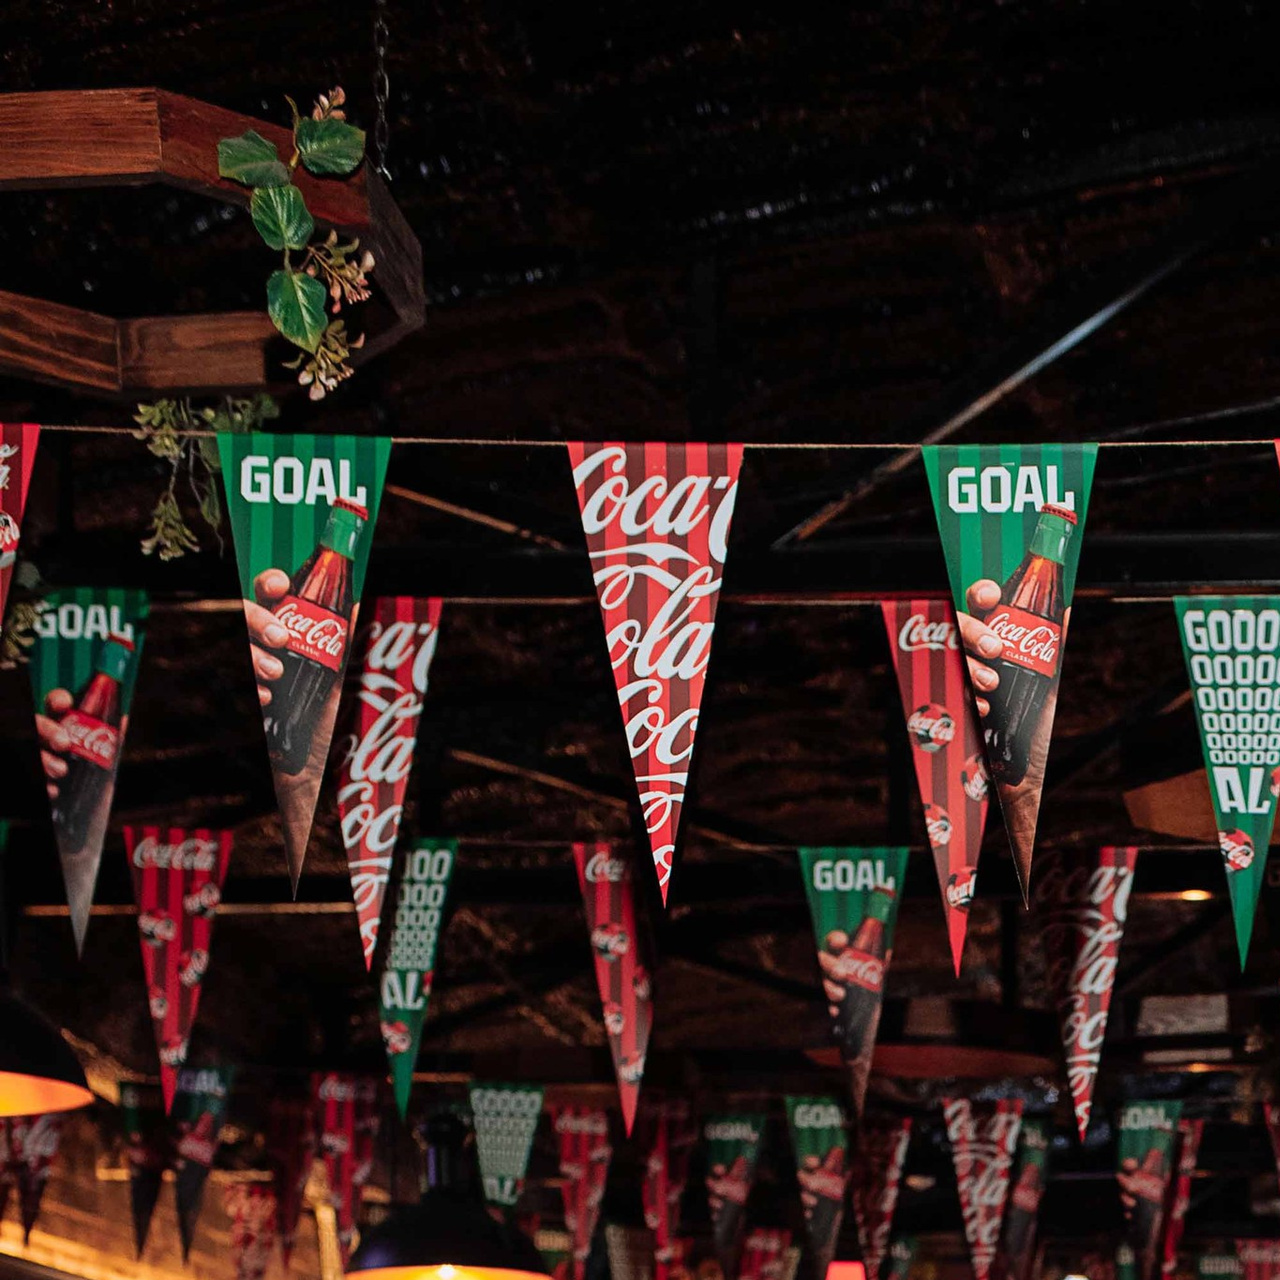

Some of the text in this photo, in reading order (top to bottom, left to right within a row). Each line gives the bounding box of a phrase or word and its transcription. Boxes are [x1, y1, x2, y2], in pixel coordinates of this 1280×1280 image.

[241, 456, 367, 506] GOAL
[948, 466, 1075, 512] GOAL
[33, 602, 133, 640] GOAL
[277, 603, 347, 656] Coca-Cola
[988, 613, 1060, 663] Coca-Cola
[1005, 650, 1035, 666] CLASSIC
[1212, 767, 1271, 814] AL
[813, 860, 895, 892] GOAL
[382, 970, 424, 1011] AL
